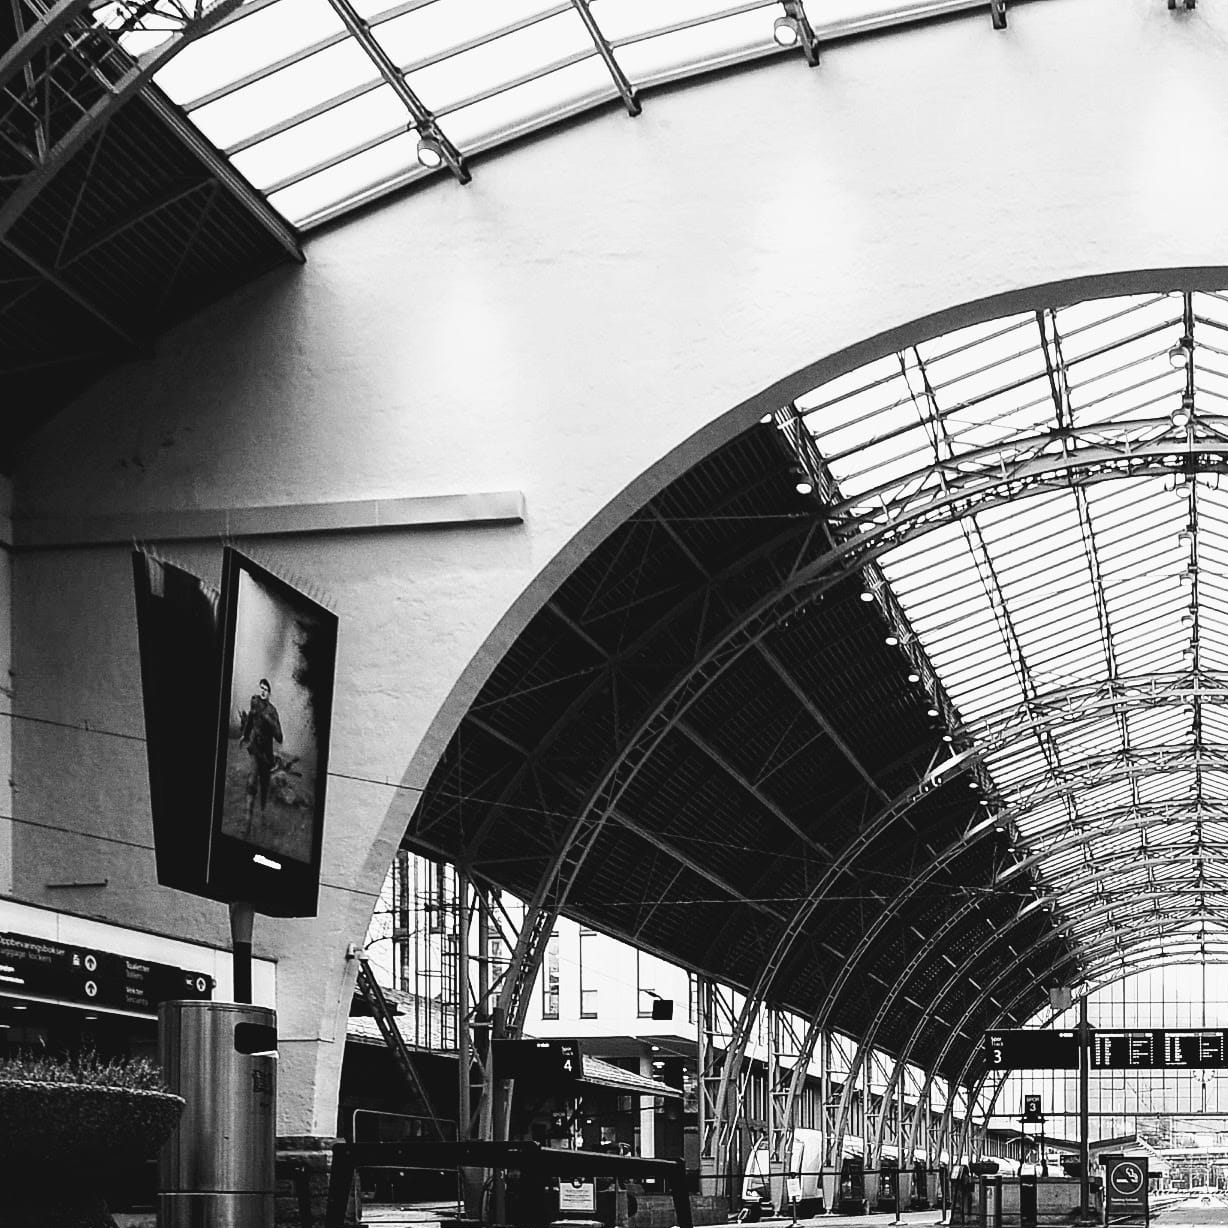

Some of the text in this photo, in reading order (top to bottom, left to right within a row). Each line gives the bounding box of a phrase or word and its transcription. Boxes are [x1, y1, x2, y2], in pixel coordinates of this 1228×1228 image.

[993, 1049, 1002, 1063] 3
[563, 1059, 573, 1072] 4
[1029, 1103, 1037, 1112] 3
